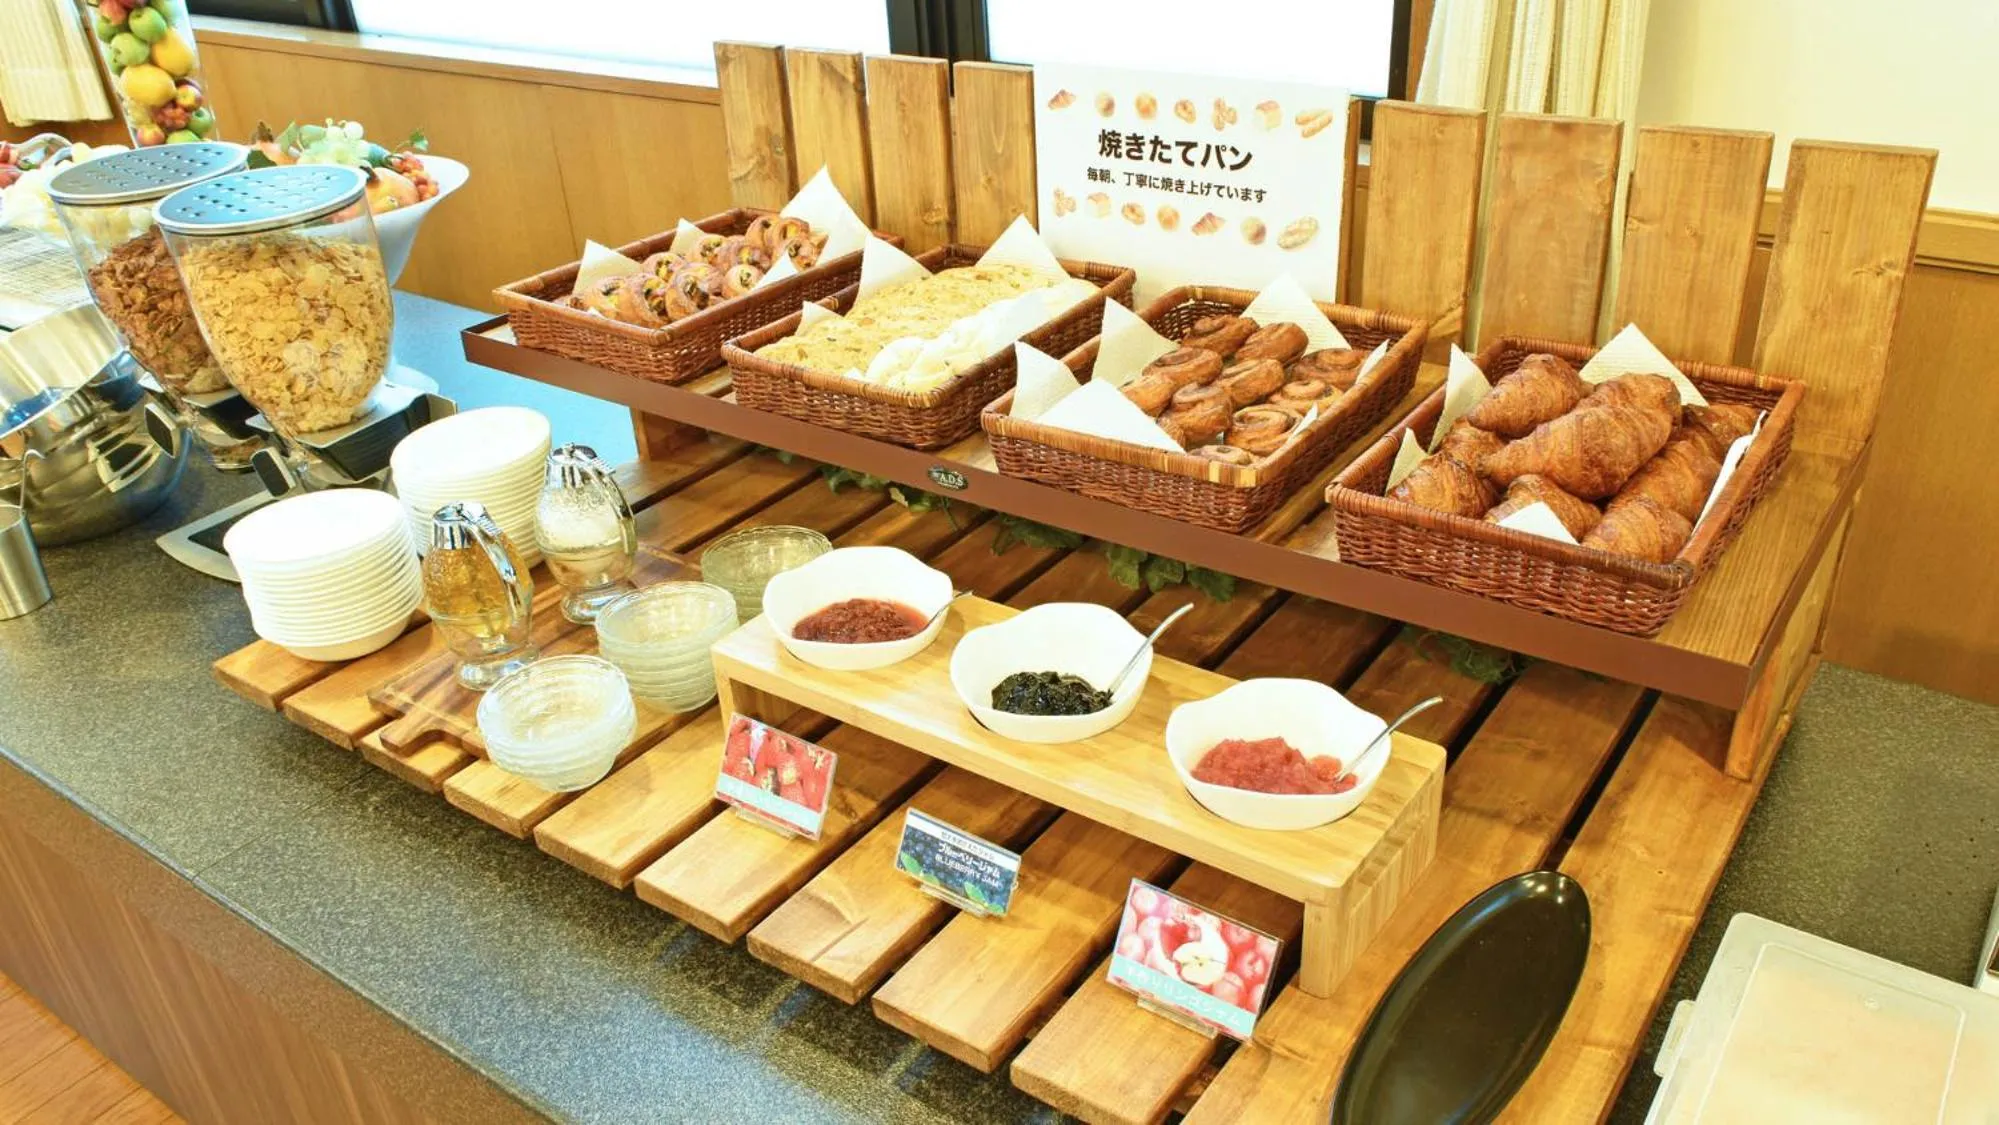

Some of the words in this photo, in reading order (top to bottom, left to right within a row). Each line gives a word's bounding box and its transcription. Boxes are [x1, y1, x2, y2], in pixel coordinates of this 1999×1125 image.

[1098, 128, 1253, 171] 焼きたてパン
[1086, 166, 1267, 204] 毎朝、丁寧に焼き上げています
